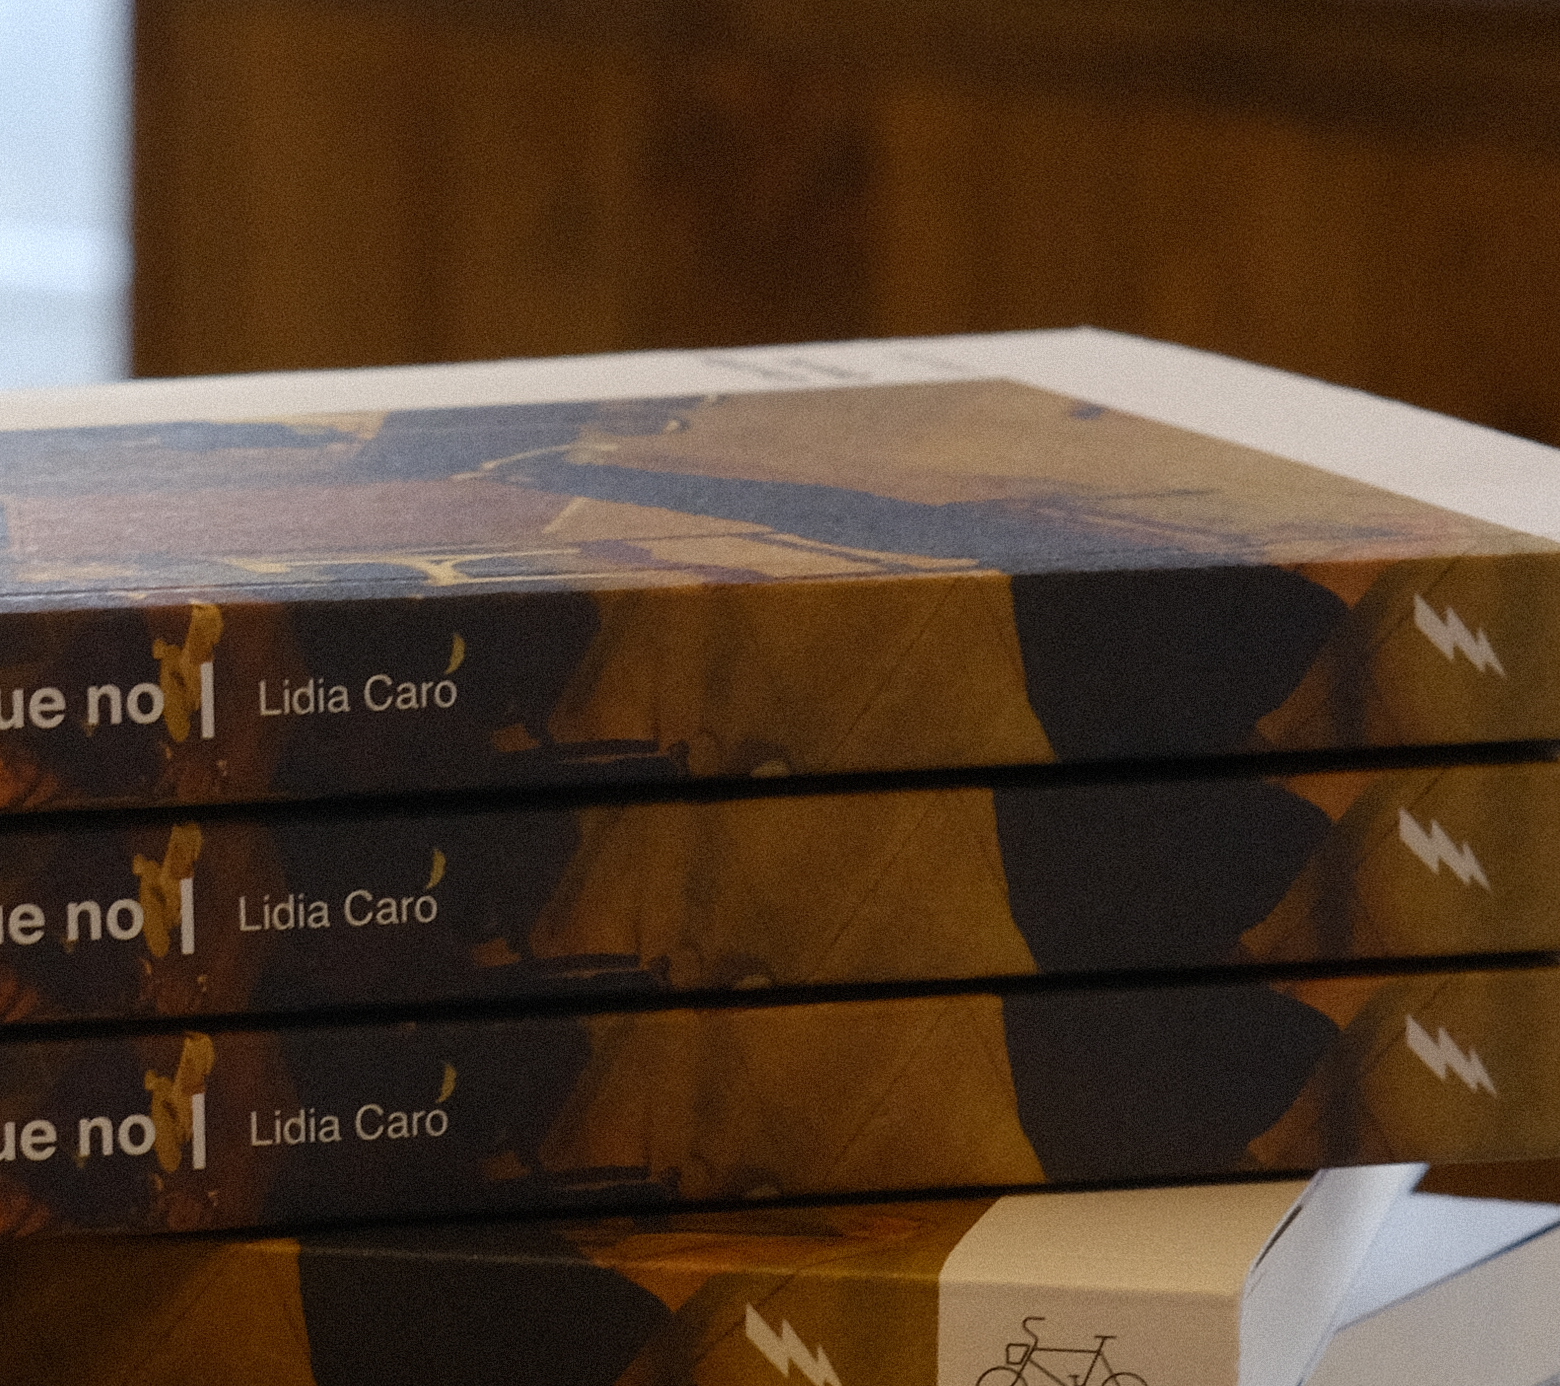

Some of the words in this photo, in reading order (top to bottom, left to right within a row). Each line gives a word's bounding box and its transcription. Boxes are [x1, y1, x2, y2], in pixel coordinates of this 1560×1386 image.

[87, 683, 166, 725] no
[258, 679, 350, 717] Lidia
[363, 672, 460, 712] Caro
[67, 899, 146, 941] no
[238, 894, 330, 932] Lidia
[343, 889, 438, 927] Caro
[79, 1114, 158, 1157] no
[250, 1109, 341, 1147] Lidia
[354, 1103, 449, 1141] Caro
